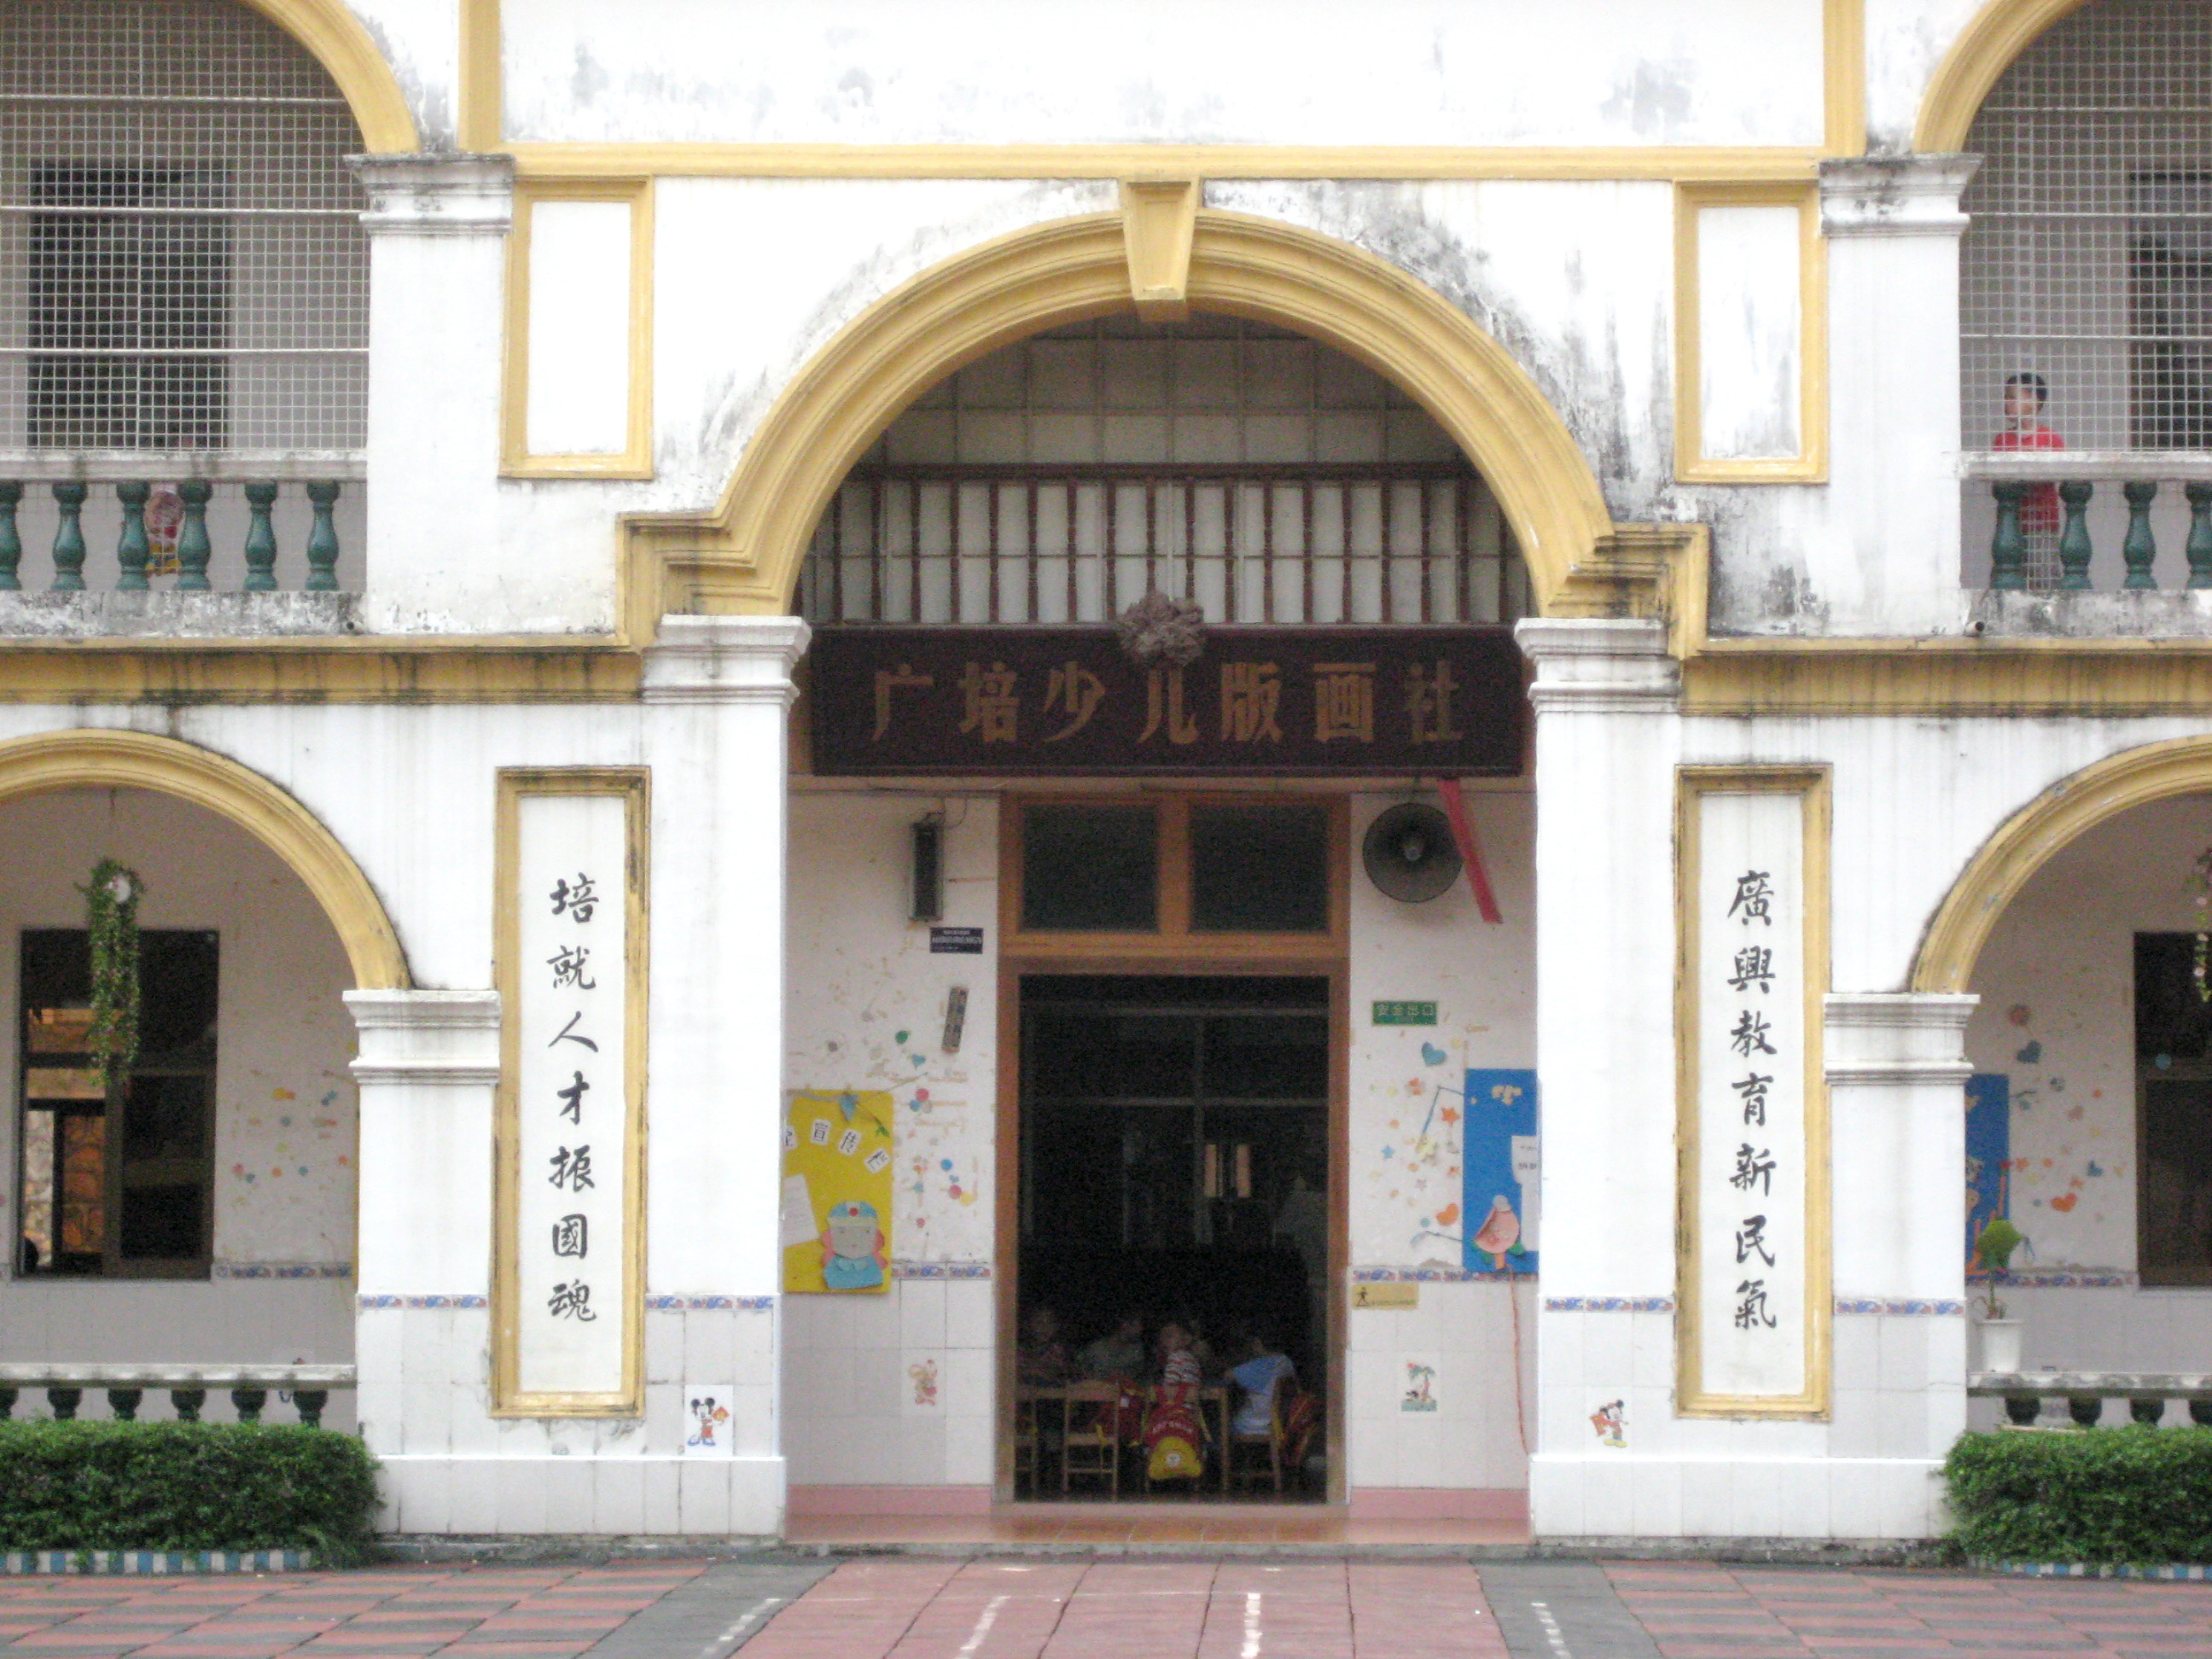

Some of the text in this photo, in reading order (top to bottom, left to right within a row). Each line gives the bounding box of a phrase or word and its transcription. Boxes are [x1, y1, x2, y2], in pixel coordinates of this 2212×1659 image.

[871, 660, 1464, 745] 广培少儿版画社
[547, 873, 599, 1322] 培就人才振國魂
[1727, 870, 1778, 1330] 廣興教育新民氣
